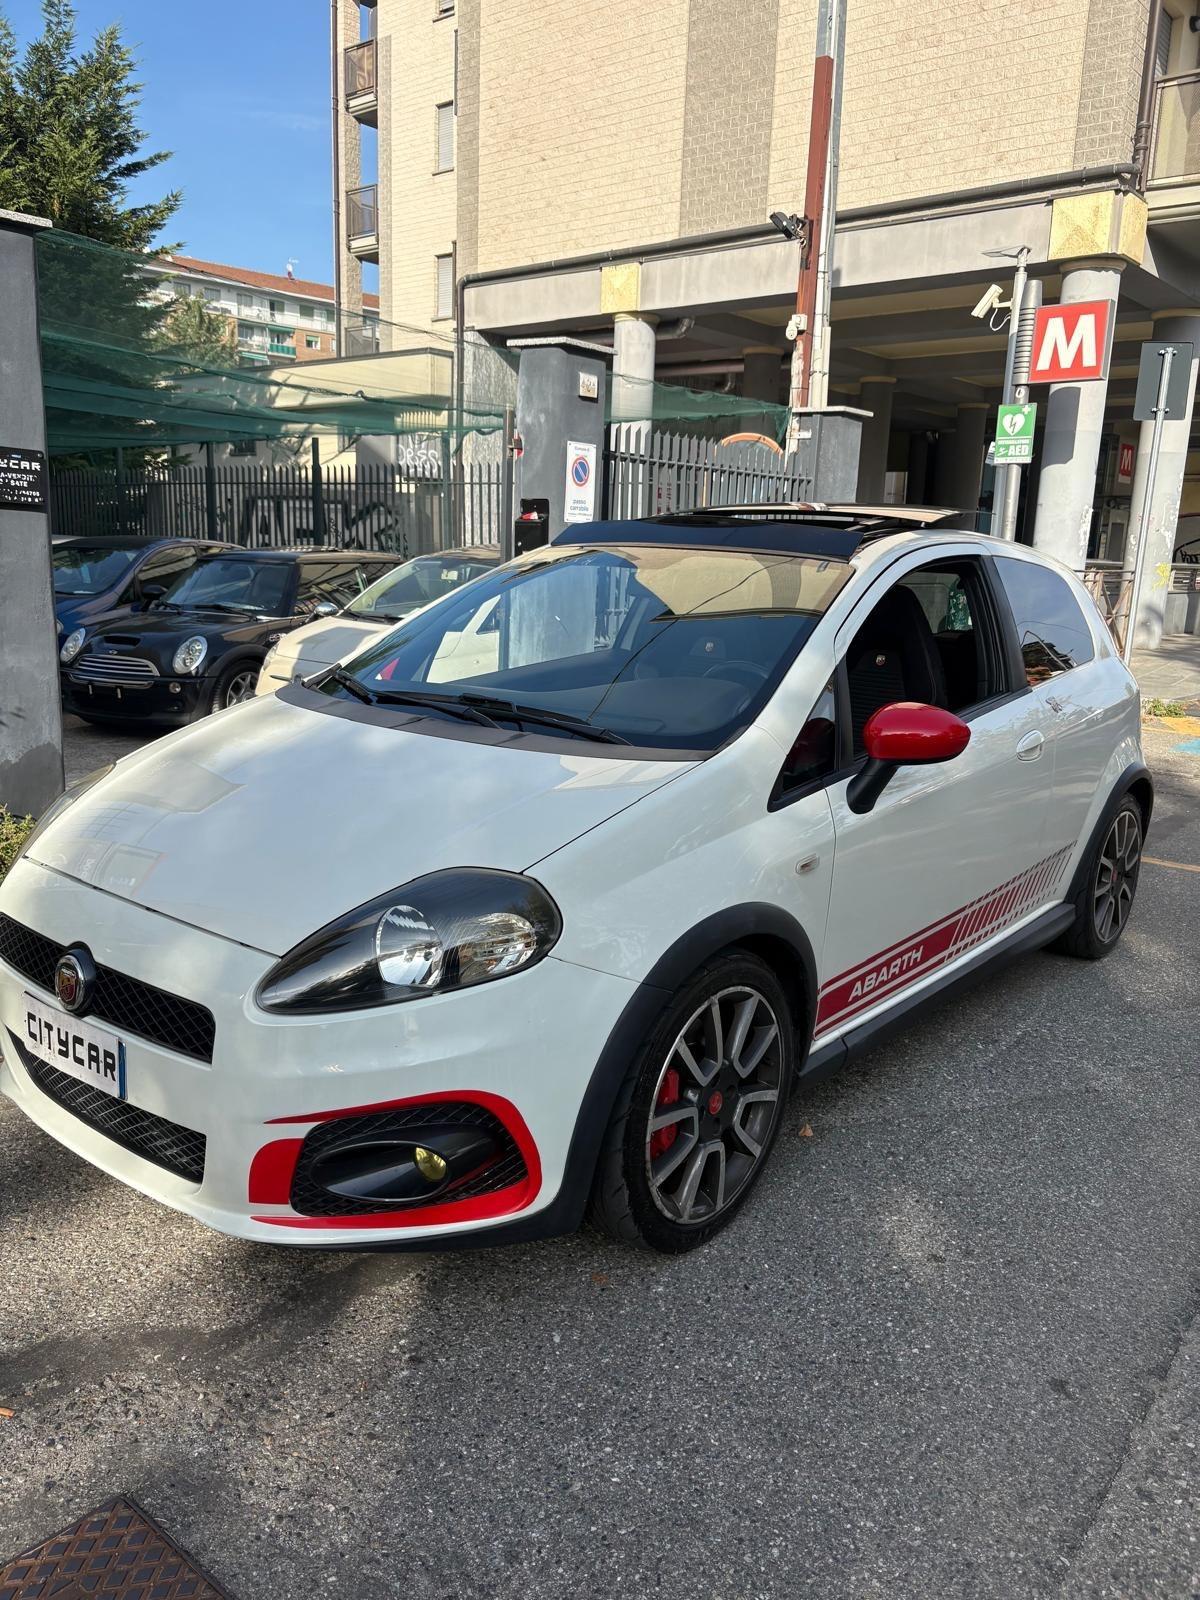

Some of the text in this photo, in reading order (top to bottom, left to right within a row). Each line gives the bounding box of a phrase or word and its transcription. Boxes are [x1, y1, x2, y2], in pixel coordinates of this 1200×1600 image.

[1036, 313, 1097, 371] M
[1008, 444, 1029, 456] AED
[1120, 448, 1132, 471] M
[848, 945, 924, 1002] ABARTH
[27, 1011, 117, 1082] CITYCAR
